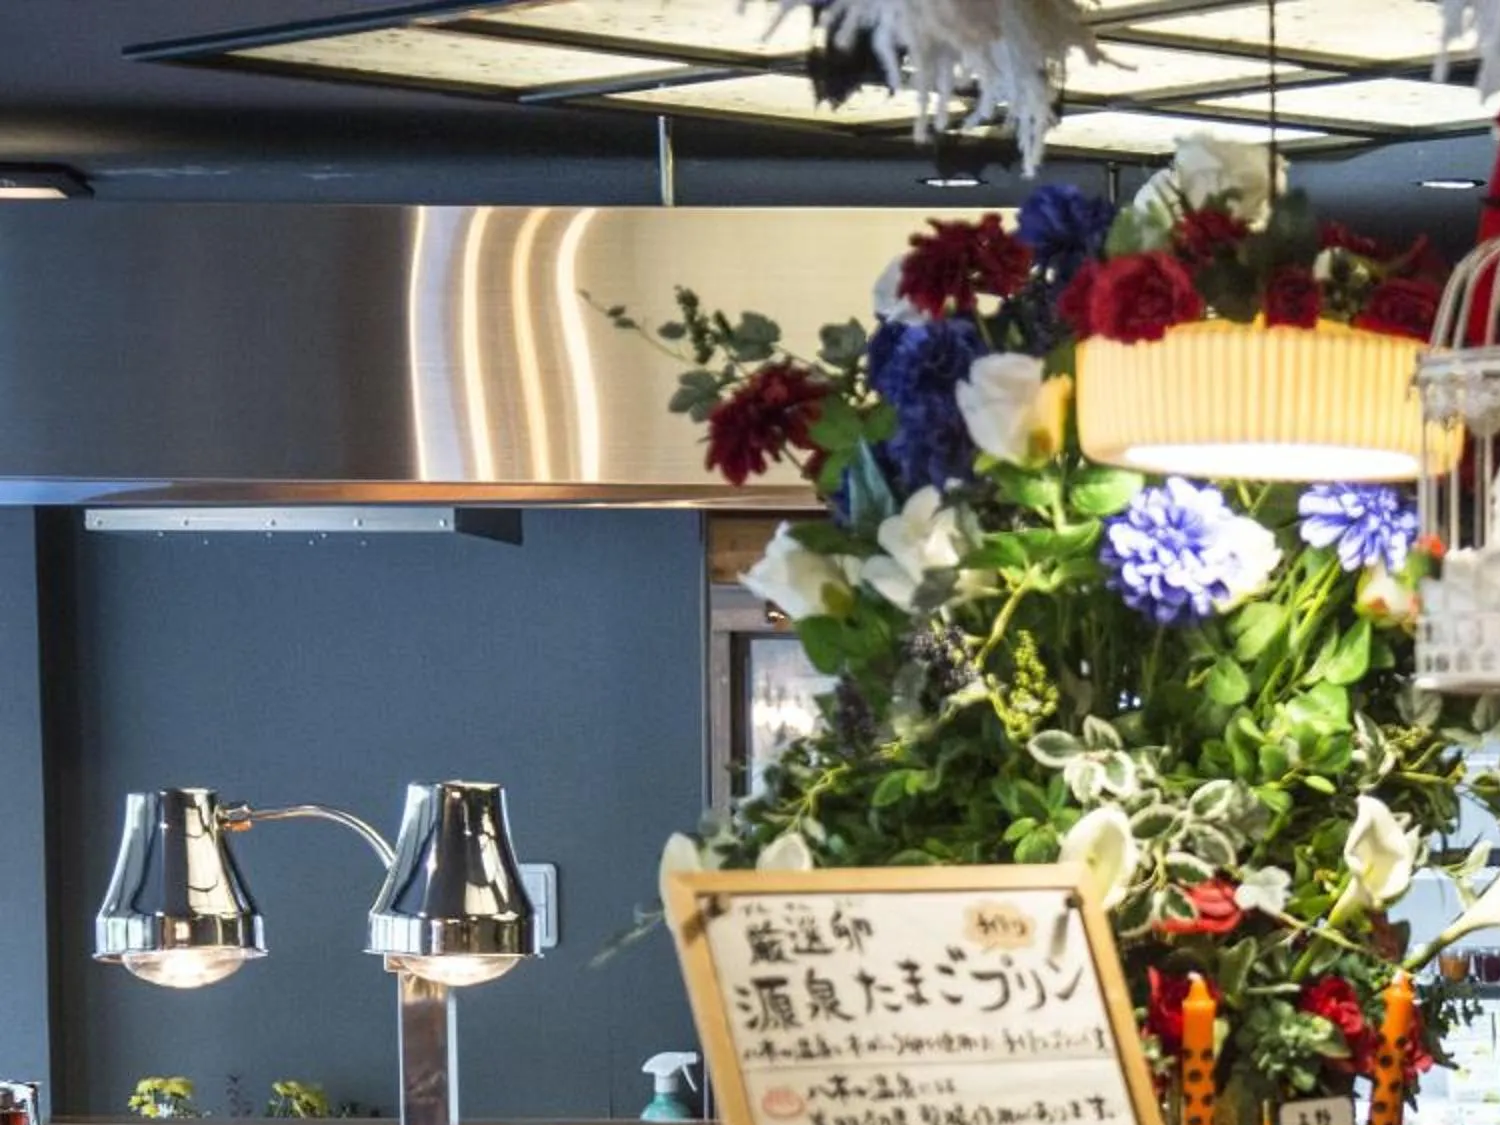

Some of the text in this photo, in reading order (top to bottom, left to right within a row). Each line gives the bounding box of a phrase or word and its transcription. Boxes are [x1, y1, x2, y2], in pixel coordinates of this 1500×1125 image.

[734, 945, 1084, 1032] 源泉たまごプリン
